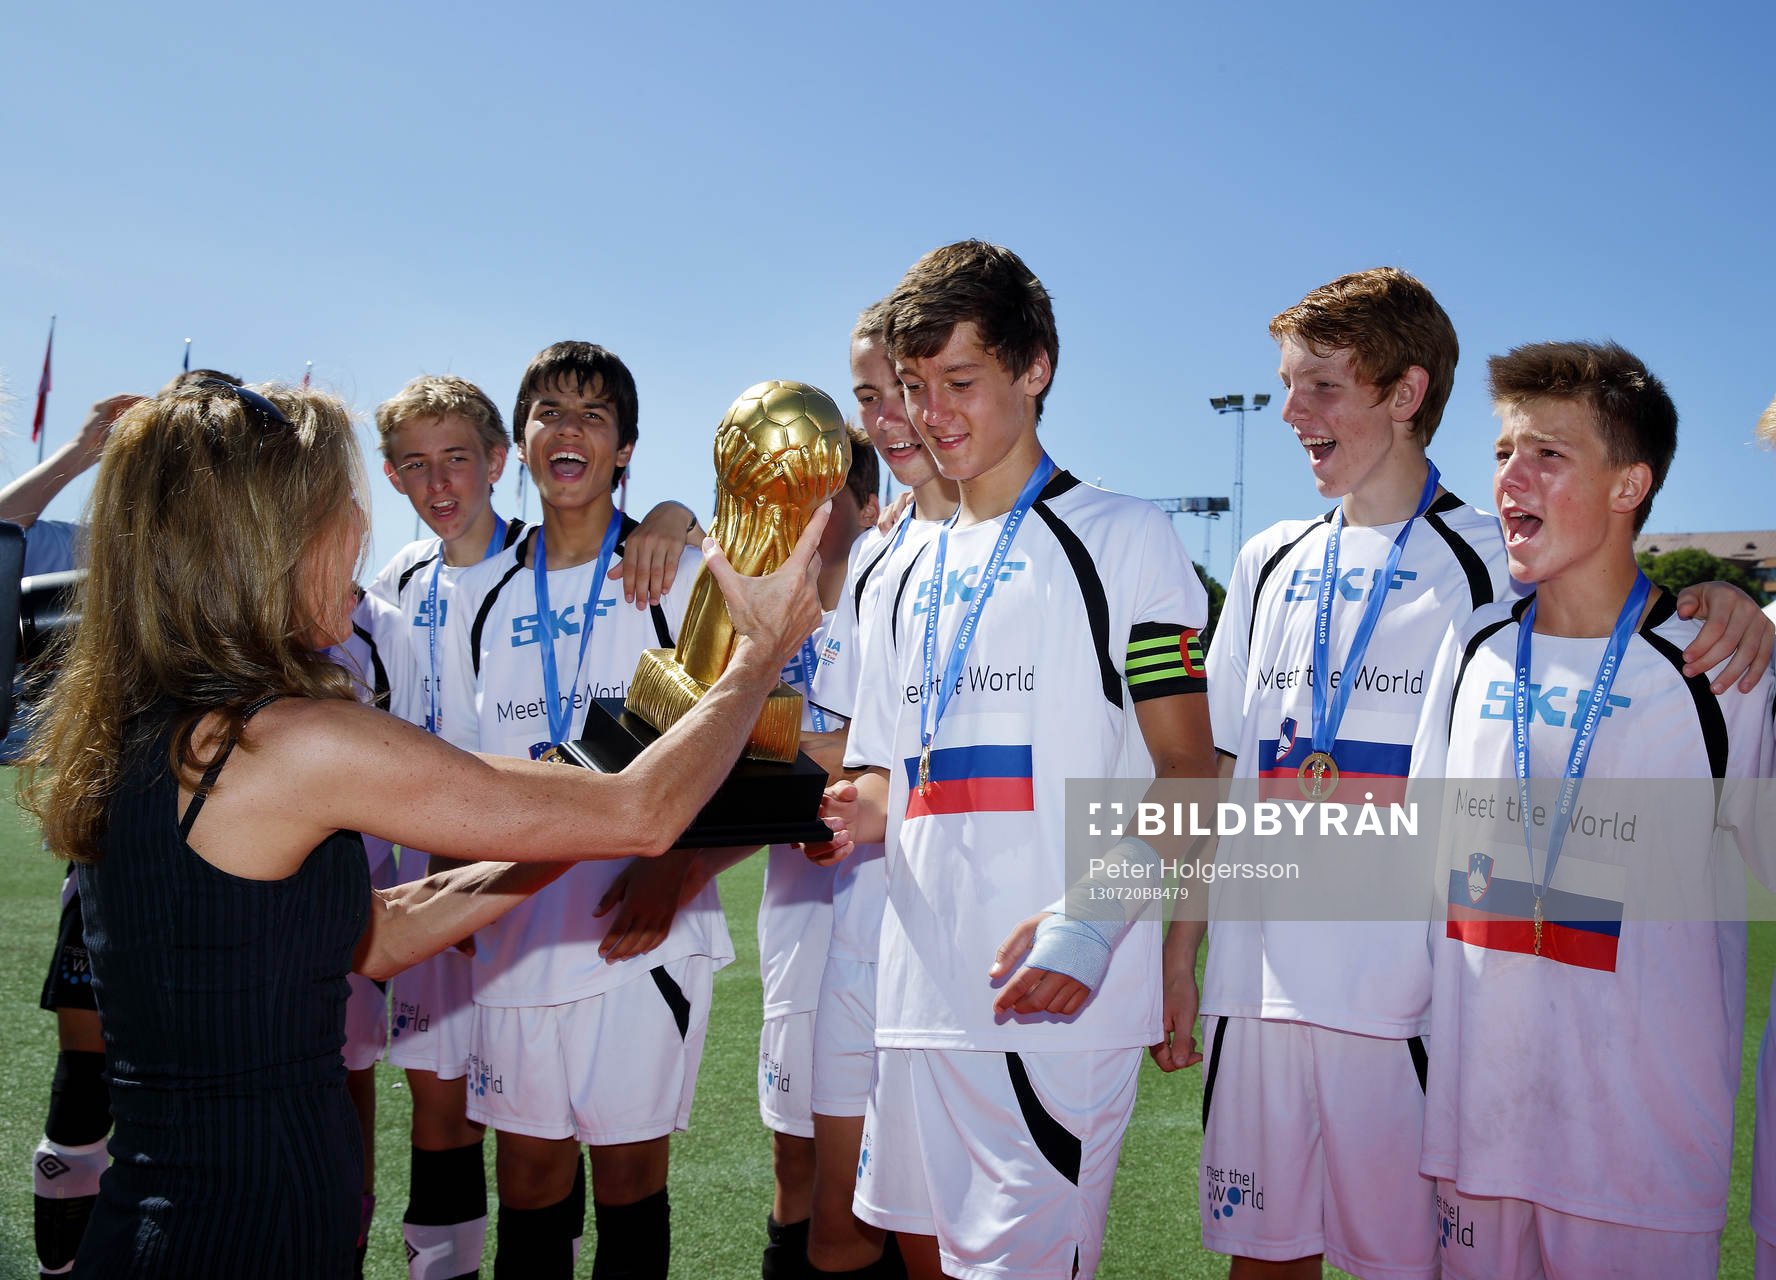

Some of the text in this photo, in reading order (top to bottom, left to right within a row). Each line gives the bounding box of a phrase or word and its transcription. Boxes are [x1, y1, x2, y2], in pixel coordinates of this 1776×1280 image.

[958, 616, 975, 651] GOTHIA
[971, 579, 988, 614] WORLD
[985, 551, 1002, 582] YOUTH
[999, 533, 1010, 551] CUP
[1007, 509, 1022, 532] 2013
[1326, 552, 1335, 579] YOUTH
[913, 561, 1027, 616] SKF
[930, 587, 938, 605] CUP
[1284, 567, 1418, 602] SKF
[1321, 581, 1332, 612] WORLD
[511, 598, 617, 647] SKF
[928, 605, 936, 635] YOUTH
[1319, 611, 1328, 645] GOTHIA
[1179, 629, 1207, 679] C
[902, 674, 942, 705] eet
[969, 665, 1035, 692] World
[1257, 665, 1425, 695] Meet te World
[1518, 667, 1526, 693] 2013
[496, 697, 548, 723] Meet
[557, 691, 582, 714] he
[1480, 680, 1632, 729] SKF
[1517, 696, 1525, 714] CUP
[1517, 712, 1525, 749] YOUTH
[1560, 655, 1617, 815] GOTHIA WORLD YOUTH CUP 2013
[1518, 750, 1527, 788] WORLD
[1455, 787, 1496, 819] Meet
[1229, 1168, 1250, 1186] the
